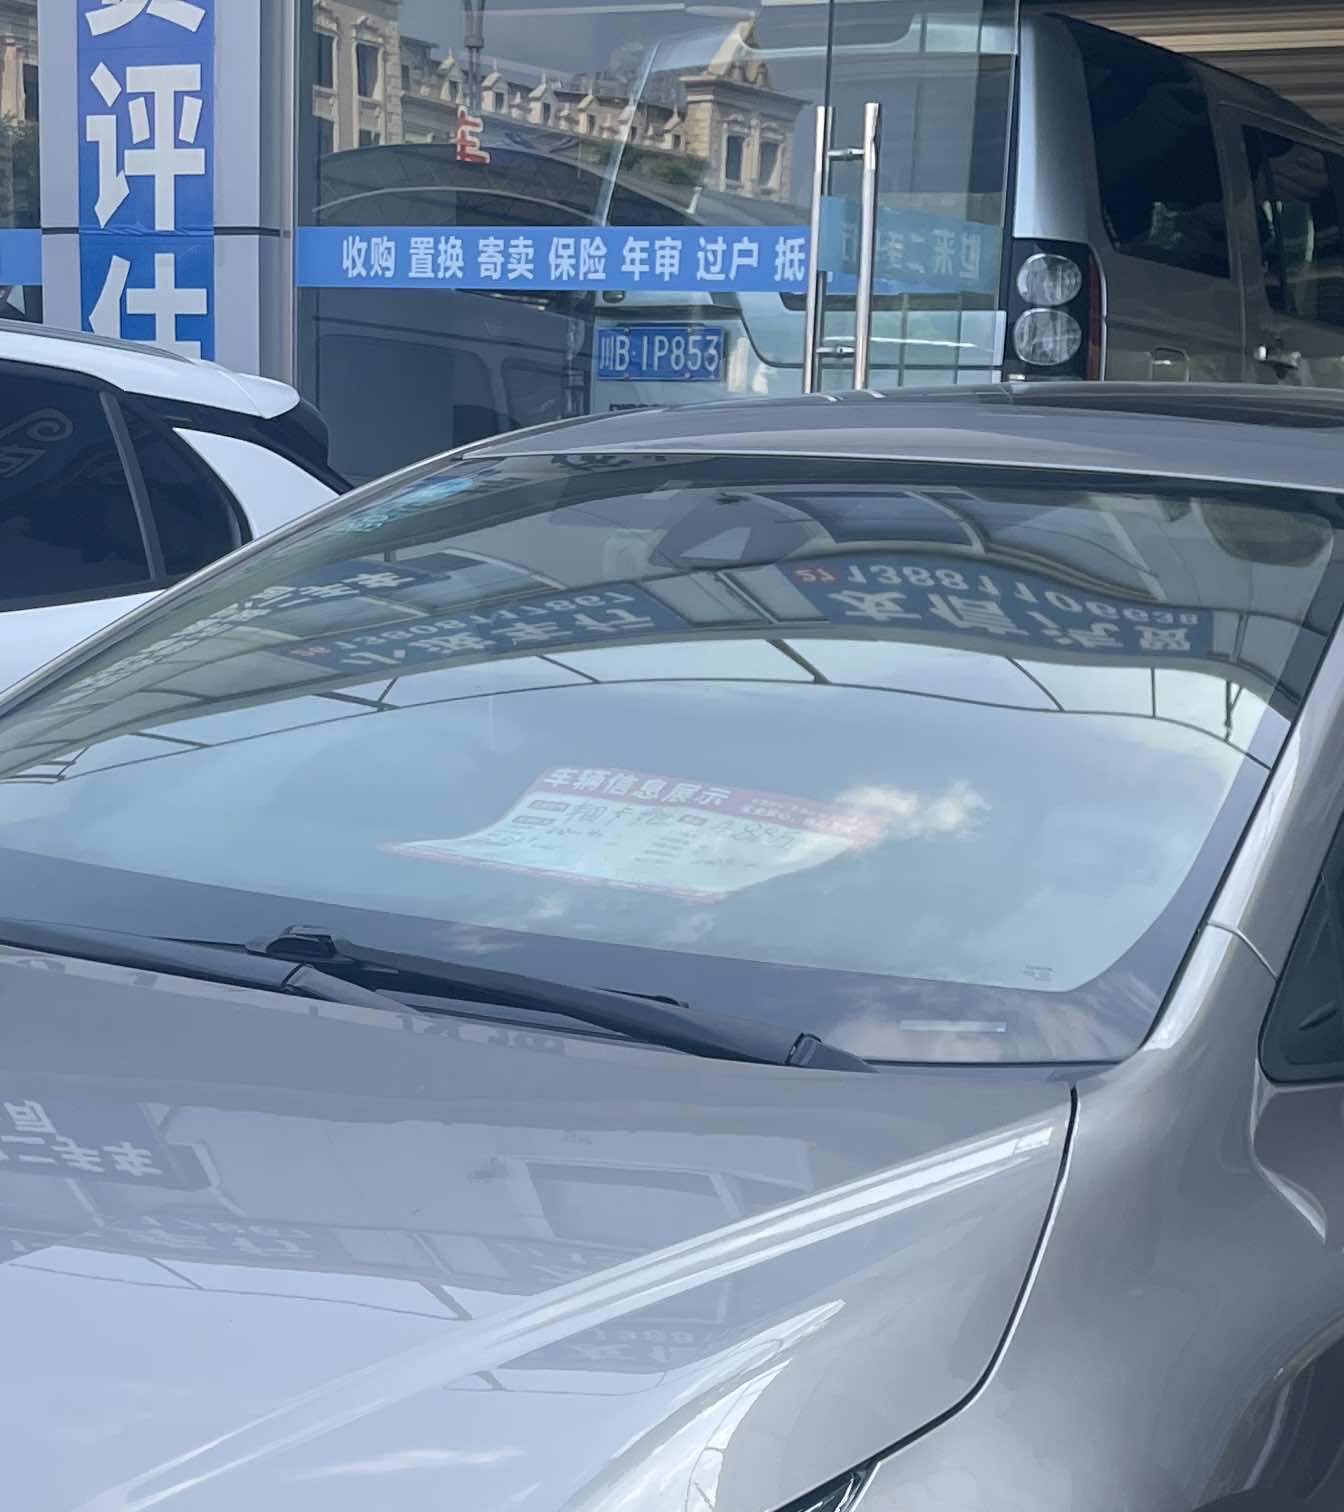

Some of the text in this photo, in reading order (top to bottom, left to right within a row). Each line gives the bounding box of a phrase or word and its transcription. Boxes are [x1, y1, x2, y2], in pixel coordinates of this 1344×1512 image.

[342, 236, 396, 279] 收购
[408, 236, 465, 279] 置换
[477, 236, 535, 280] 寄卖
[548, 236, 608, 281] 保险
[621, 236, 683, 282] 年审
[696, 236, 759, 282] 过户
[599, 334, 720, 372] 川B·1P853
[543, 766, 733, 807] 车辆信息展示
